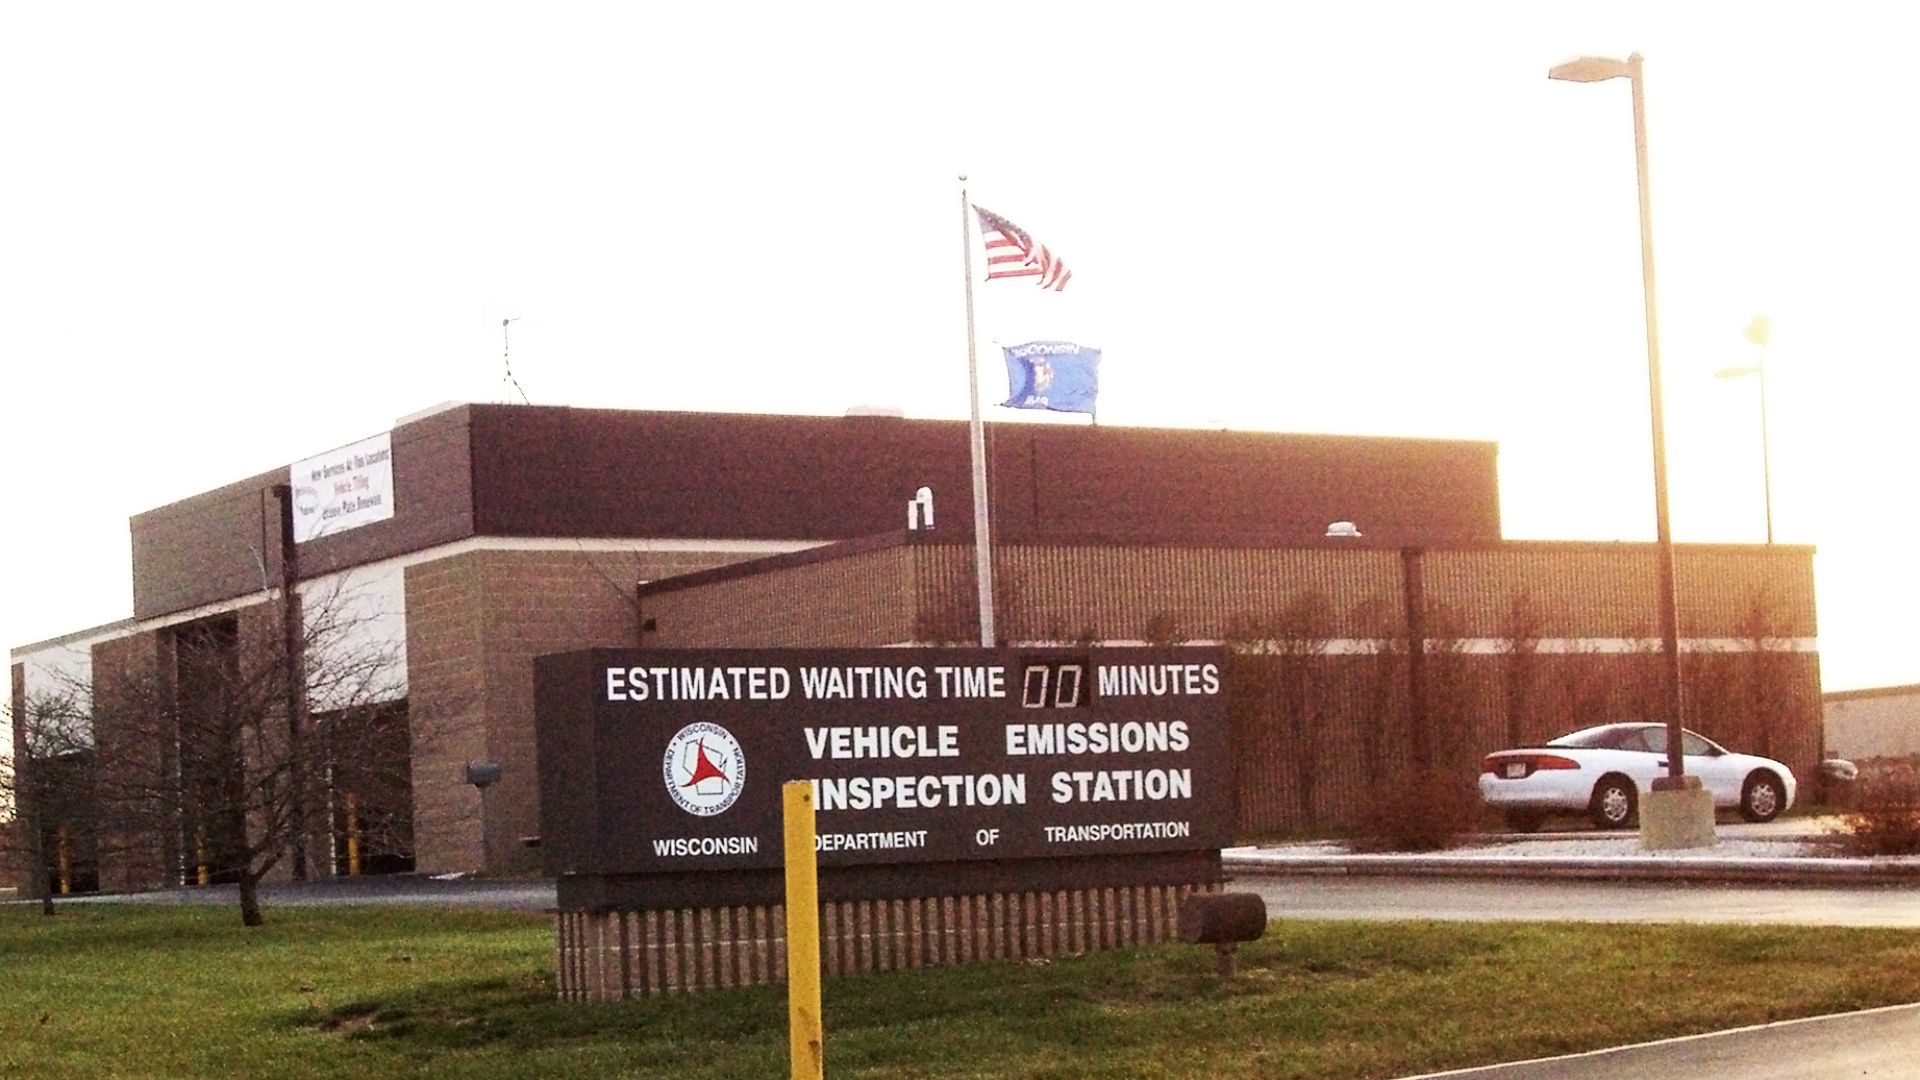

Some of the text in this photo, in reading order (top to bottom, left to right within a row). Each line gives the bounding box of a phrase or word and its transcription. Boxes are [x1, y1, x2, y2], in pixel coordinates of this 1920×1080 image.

[606, 664, 1220, 709] ESTIMATED WAITING TIME 00 MINUTES
[677, 723, 727, 741] WISCONSIN
[804, 721, 1190, 760] VEHICLE EMISSIONS
[811, 768, 1192, 811] INSPECTION STATION
[690, 804, 702, 815] OF
[653, 821, 1190, 857] WISCONSIN DEPARTMENT OF TRANSPORTATION
